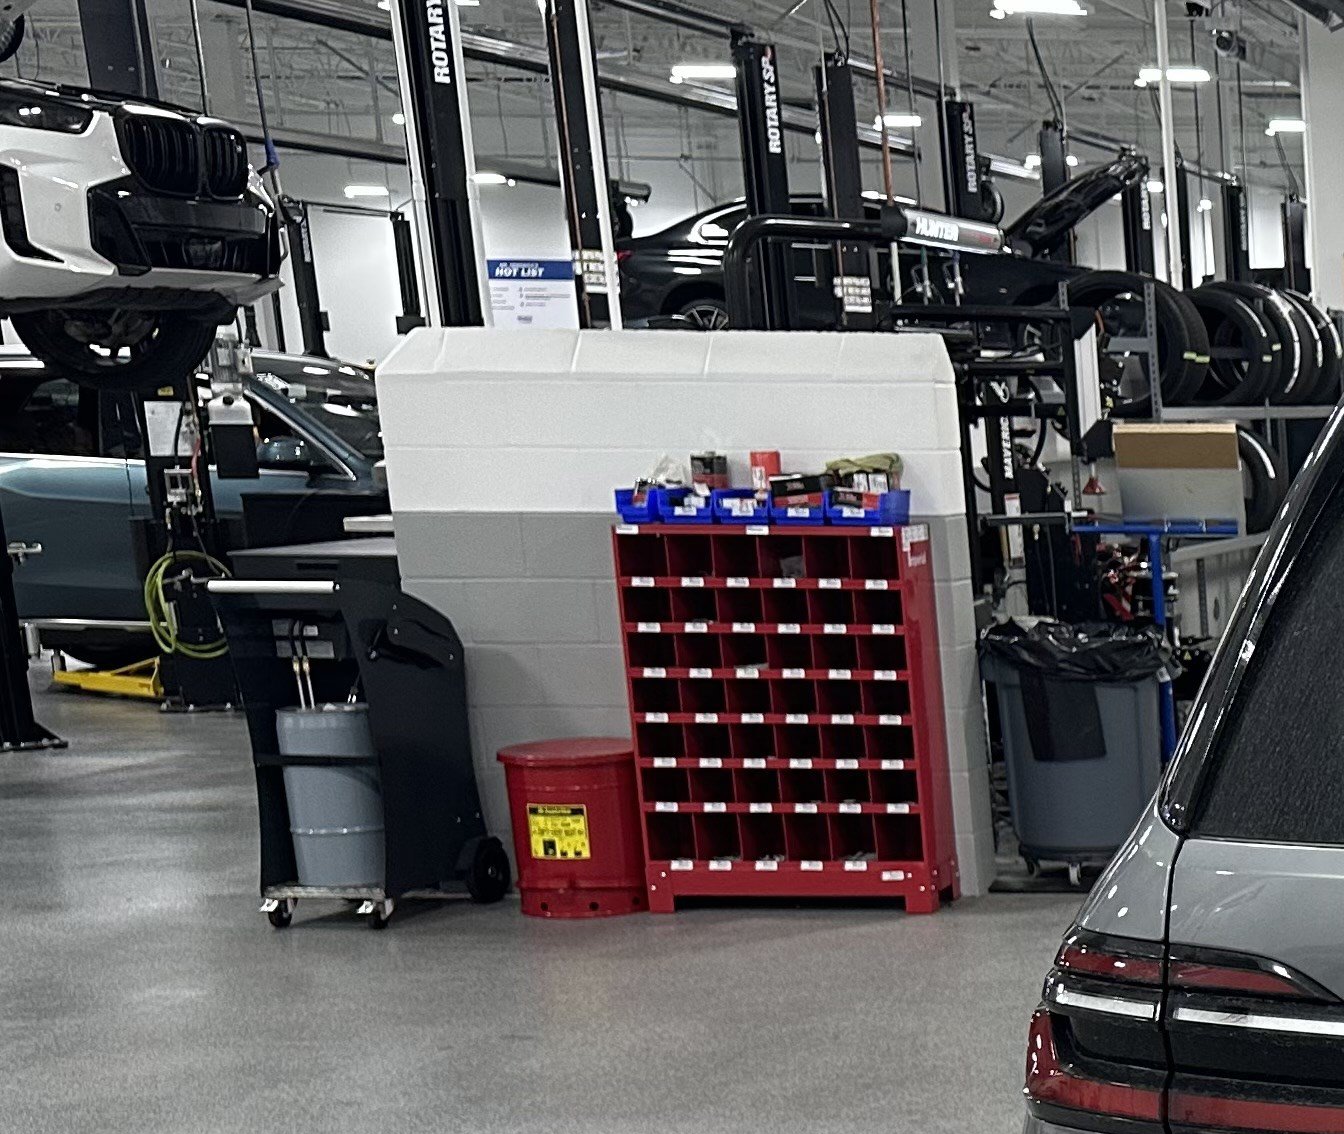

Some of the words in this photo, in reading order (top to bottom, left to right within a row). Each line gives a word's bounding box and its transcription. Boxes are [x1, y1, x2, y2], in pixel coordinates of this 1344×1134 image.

[764, 81, 781, 154] ROTARY
[915, 216, 959, 241] HUNTER
[495, 266, 518, 278] HOT
[520, 266, 545, 278] LIST
[1000, 416, 1014, 479] MAVERIC
